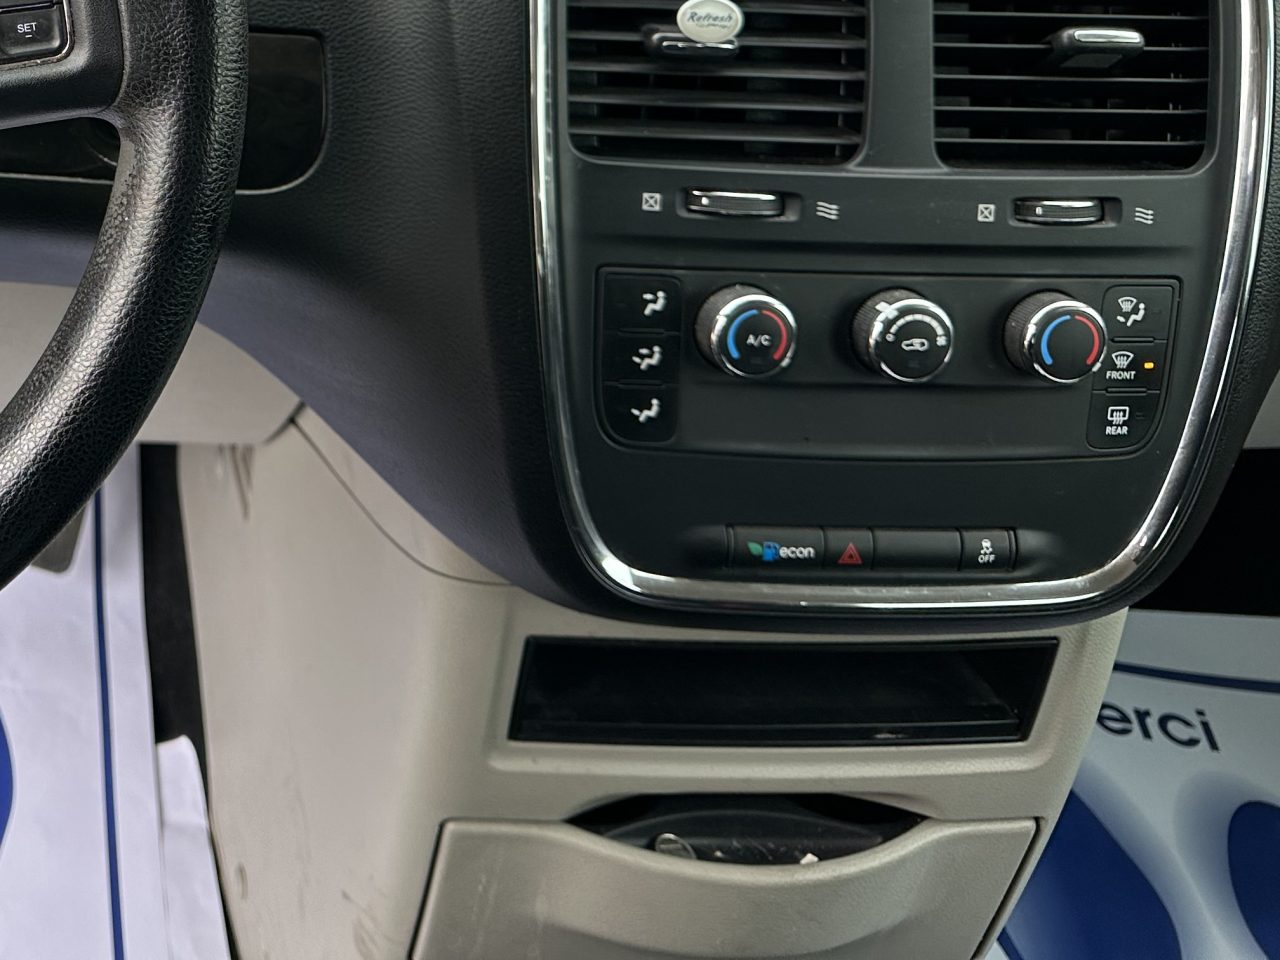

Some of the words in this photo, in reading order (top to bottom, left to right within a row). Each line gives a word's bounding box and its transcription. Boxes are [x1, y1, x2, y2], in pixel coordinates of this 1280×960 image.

[687, 11, 733, 23] Refresh
[17, 22, 37, 33] SET
[746, 334, 770, 347] A/C
[1106, 371, 1136, 380] FRONT
[1105, 426, 1128, 435] REAR
[779, 547, 815, 559] econ
[978, 553, 996, 564] OFF
[1097, 702, 1220, 752] erci
